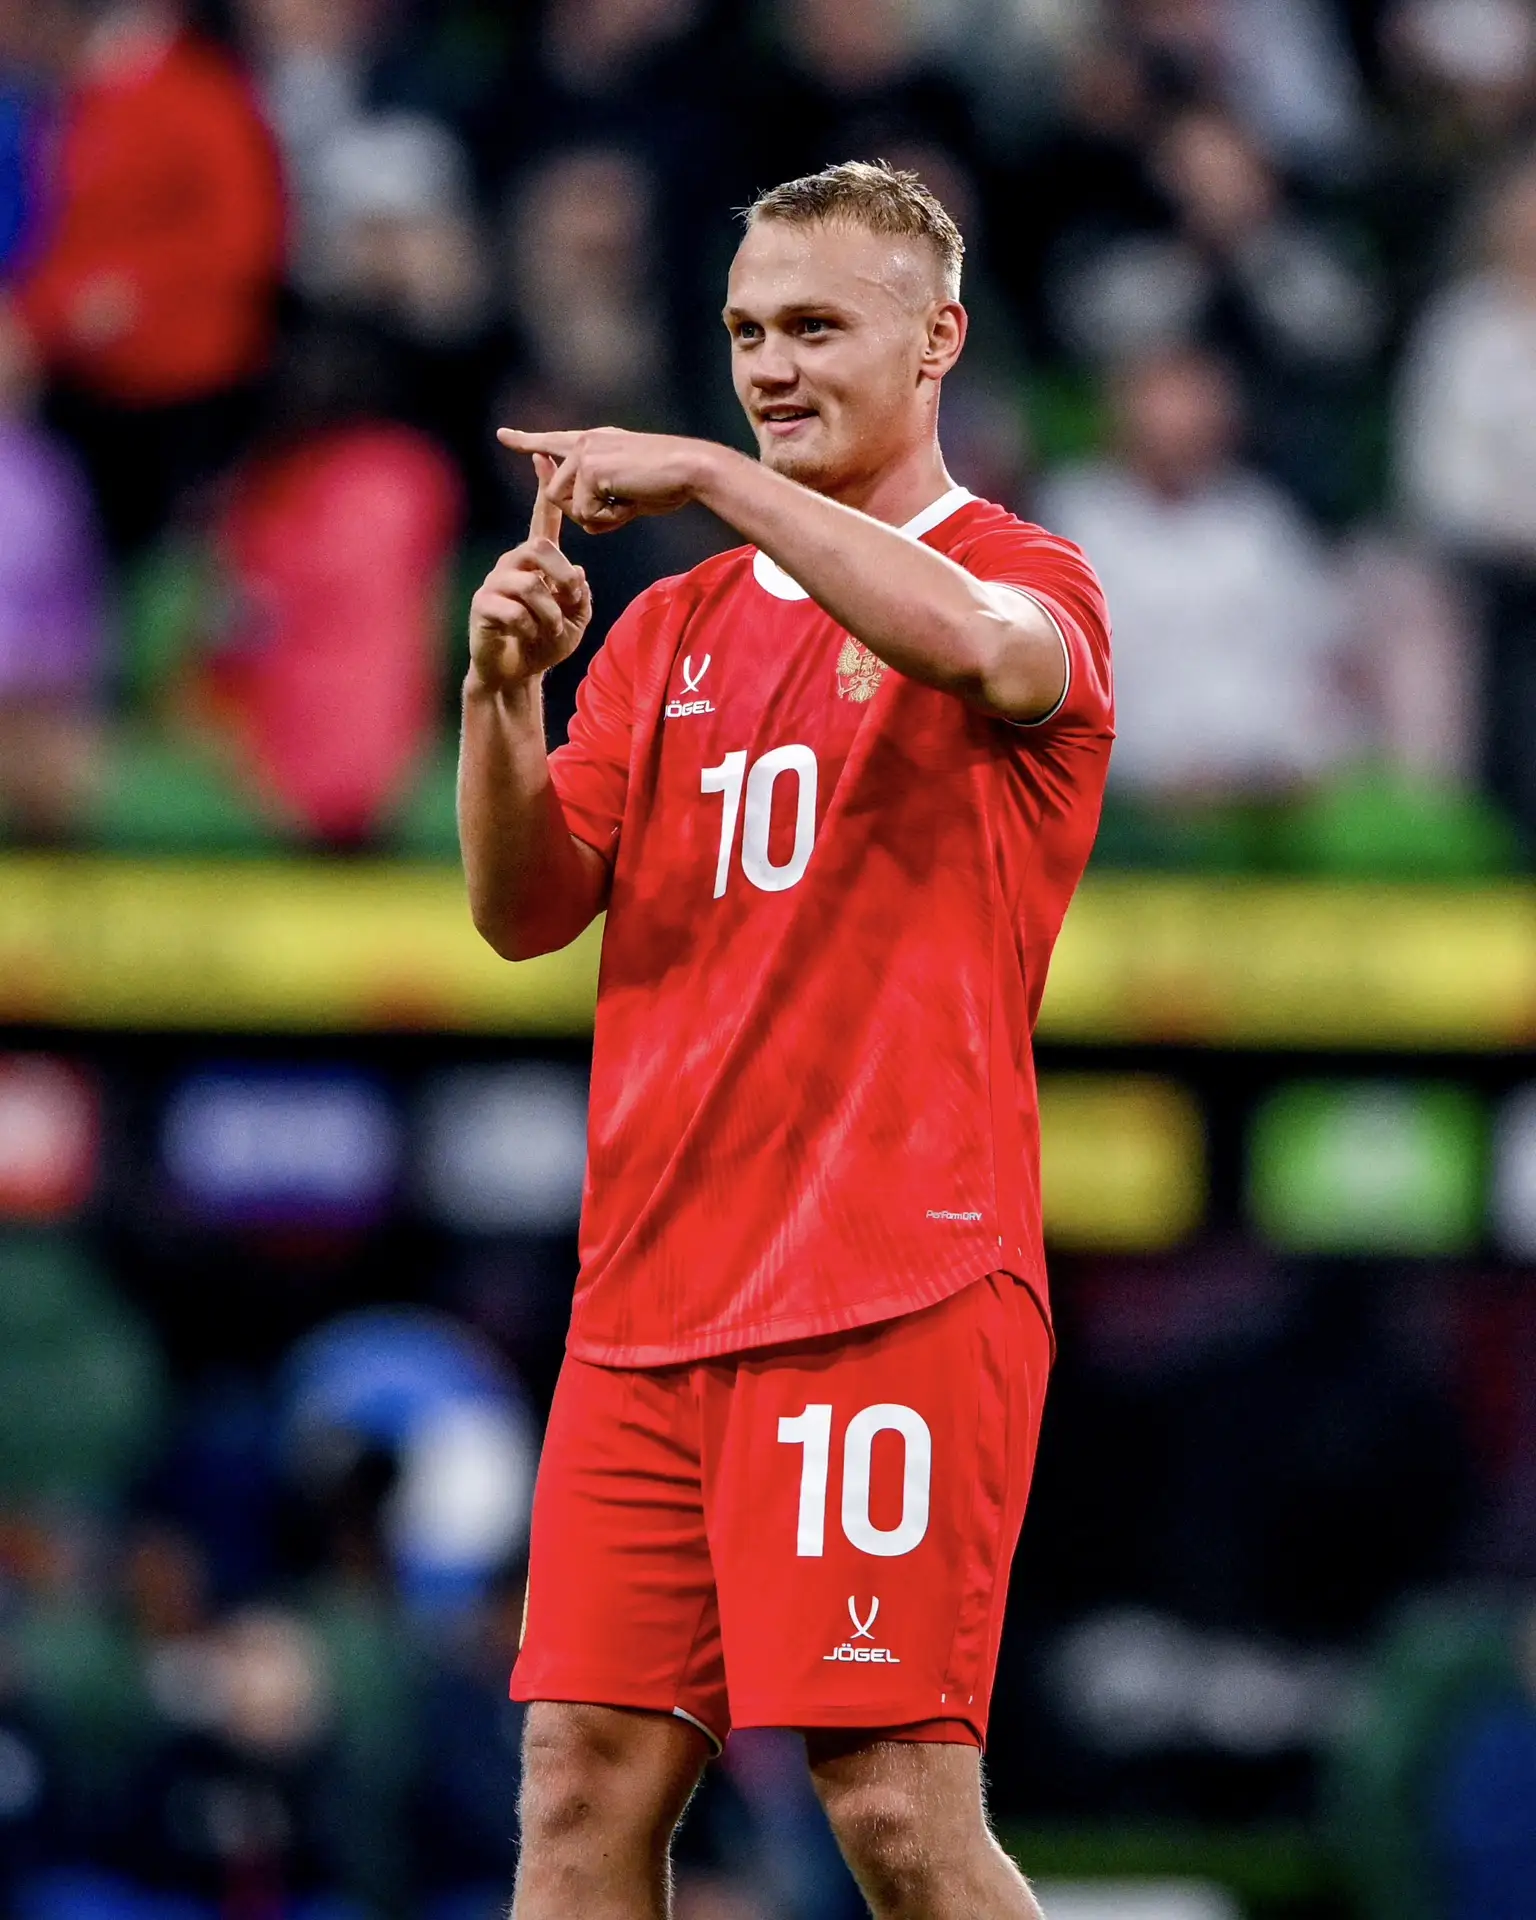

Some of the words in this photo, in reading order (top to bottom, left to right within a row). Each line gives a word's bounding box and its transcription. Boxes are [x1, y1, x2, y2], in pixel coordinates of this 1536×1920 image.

[664, 700, 715, 720] ÖGEL
[701, 744, 817, 899] 10
[777, 1403, 932, 1557] 10
[823, 1643, 900, 1663] JÖGEL
